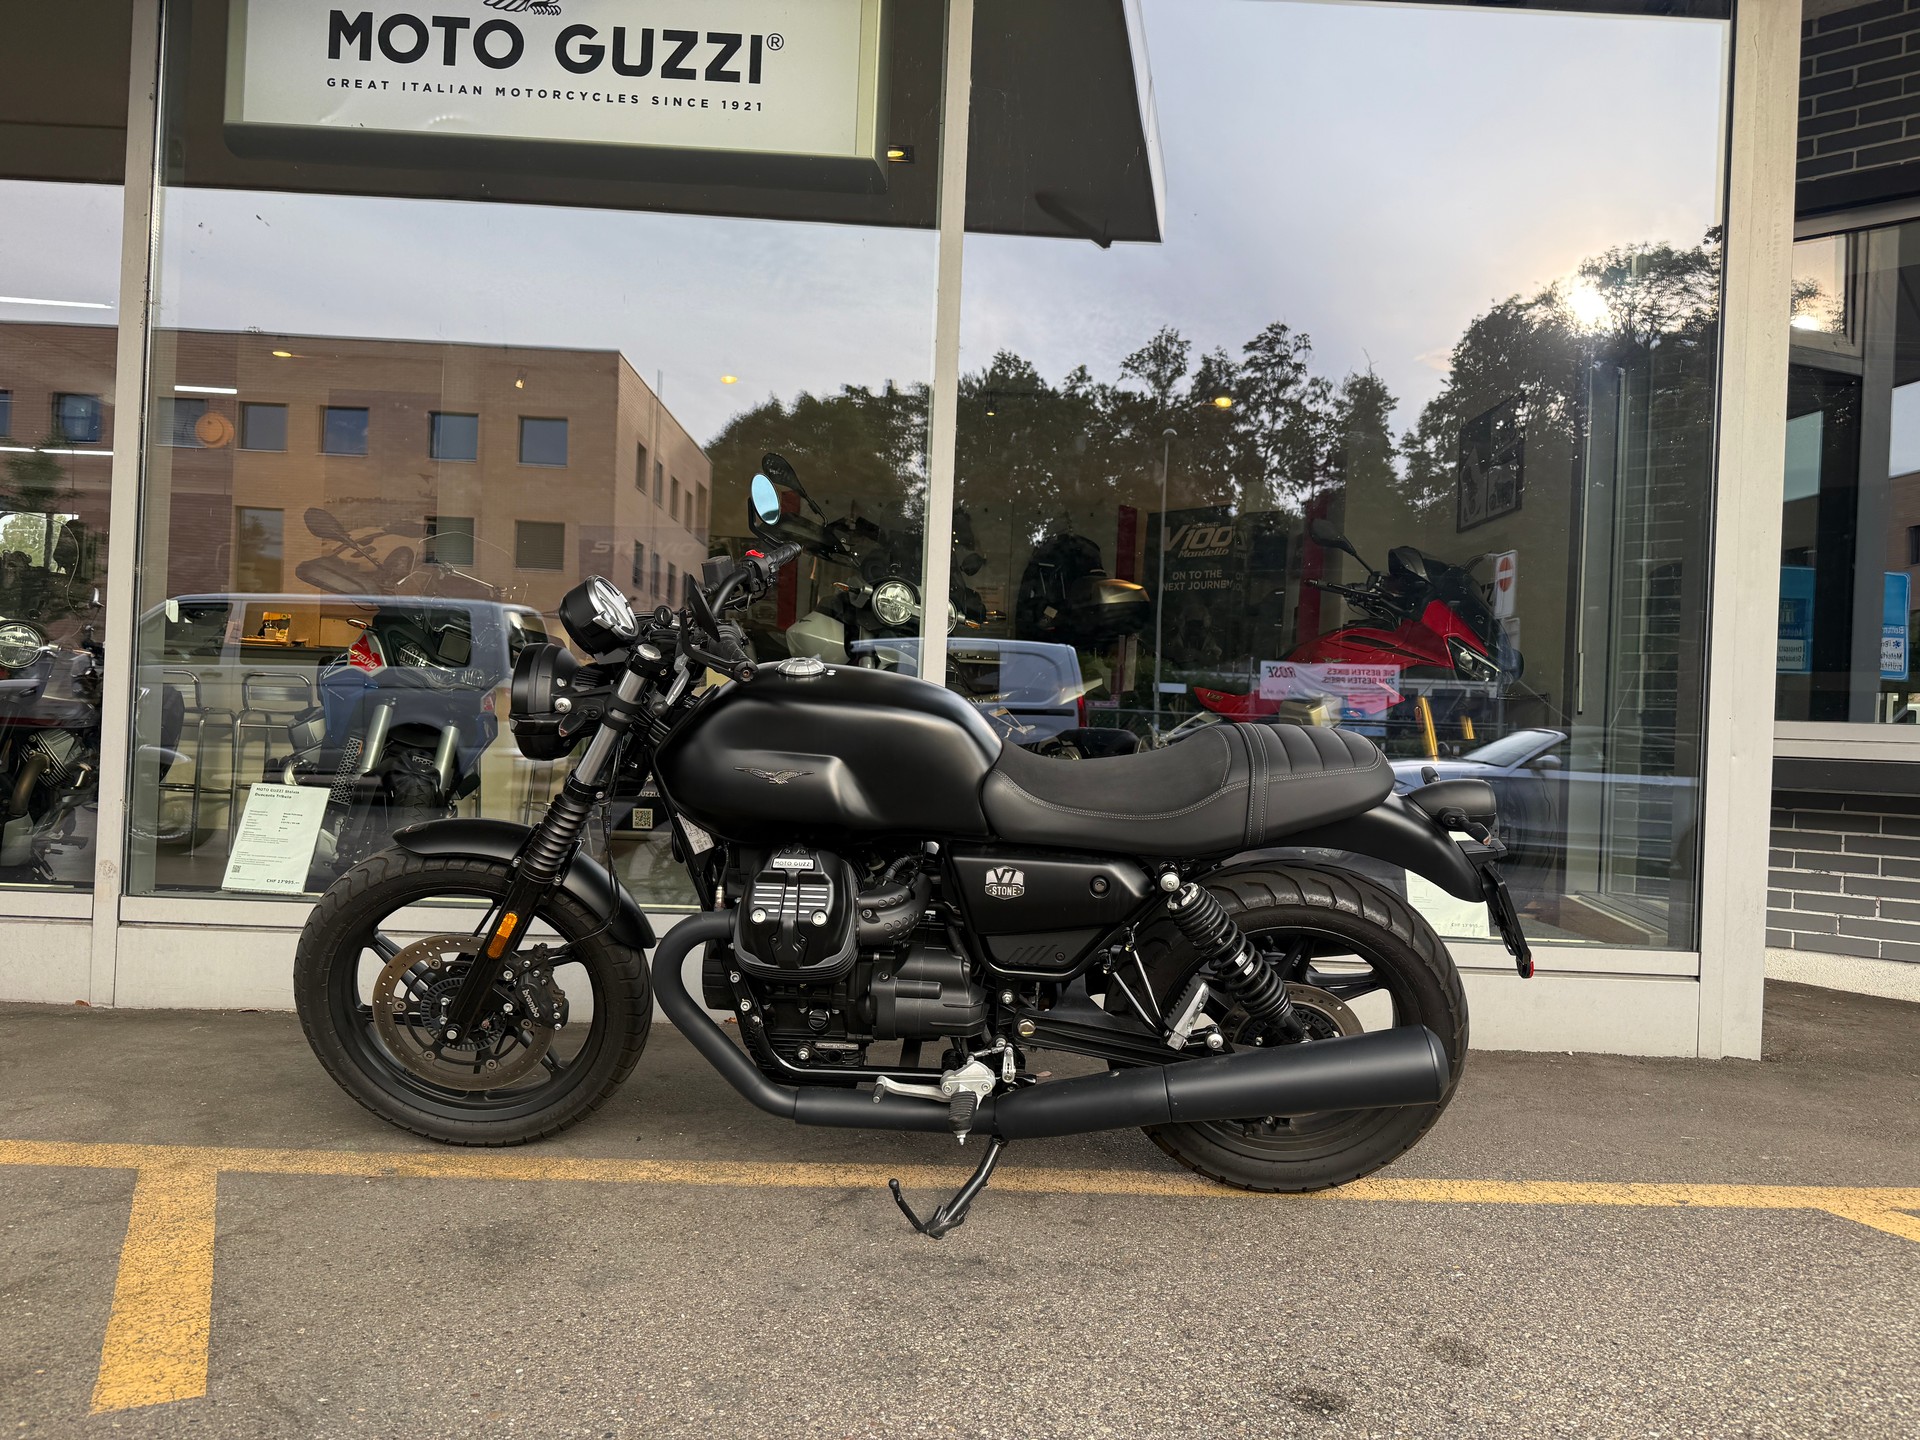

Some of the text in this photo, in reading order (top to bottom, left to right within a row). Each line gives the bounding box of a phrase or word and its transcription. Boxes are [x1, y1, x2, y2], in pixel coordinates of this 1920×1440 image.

[327, 9, 525, 70] MOTO
[326, 77, 764, 112] GREAT ITALIAN MOTORCYCLES SINCE 1921
[1164, 525, 1233, 551] V100
[1178, 548, 1229, 558] Mandello
[1172, 570, 1222, 580] ON TO THE
[1163, 582, 1185, 591] NEXT
[993, 868, 1016, 882] V7
[992, 886, 1017, 896] STONE
[522, 989, 540, 1018] brembo
